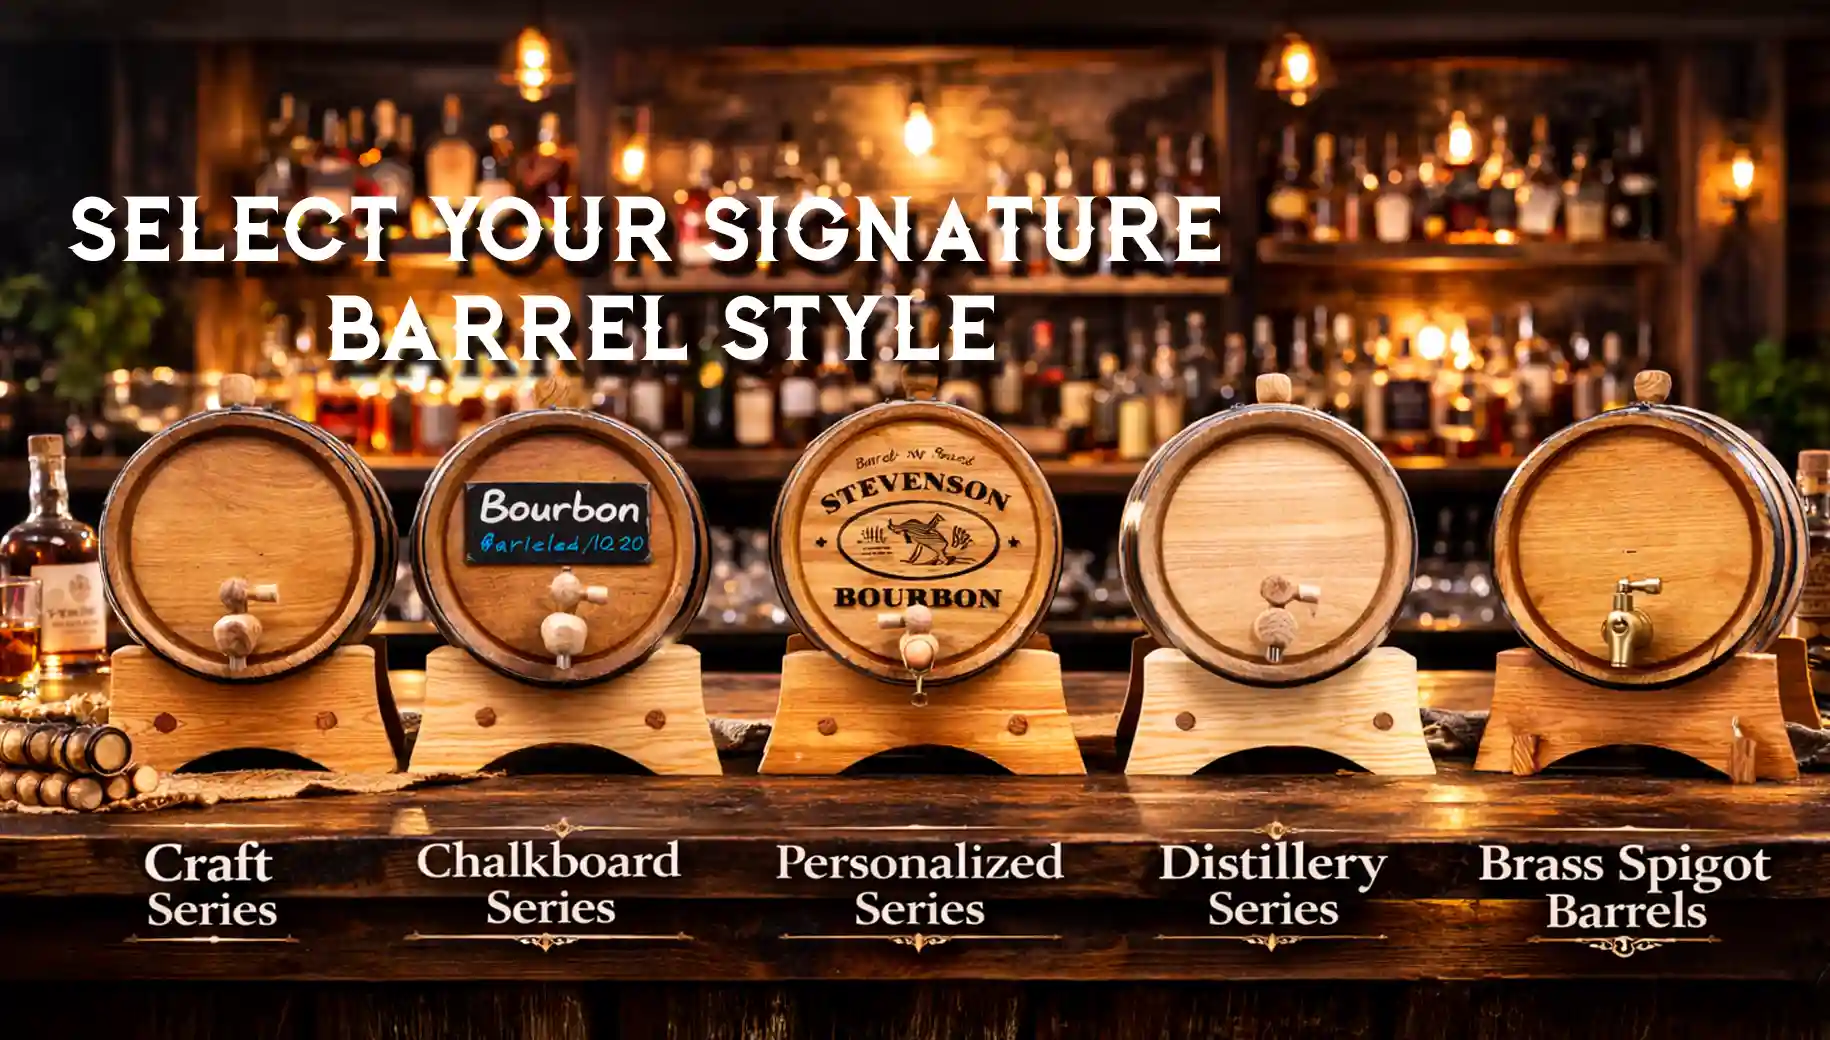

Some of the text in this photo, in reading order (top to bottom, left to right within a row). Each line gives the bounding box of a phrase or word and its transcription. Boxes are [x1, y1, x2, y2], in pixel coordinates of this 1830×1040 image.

[480, 489, 639, 523] Bourbon
[820, 471, 1012, 514] STEVENSON
[834, 587, 1002, 608] BOURBON
